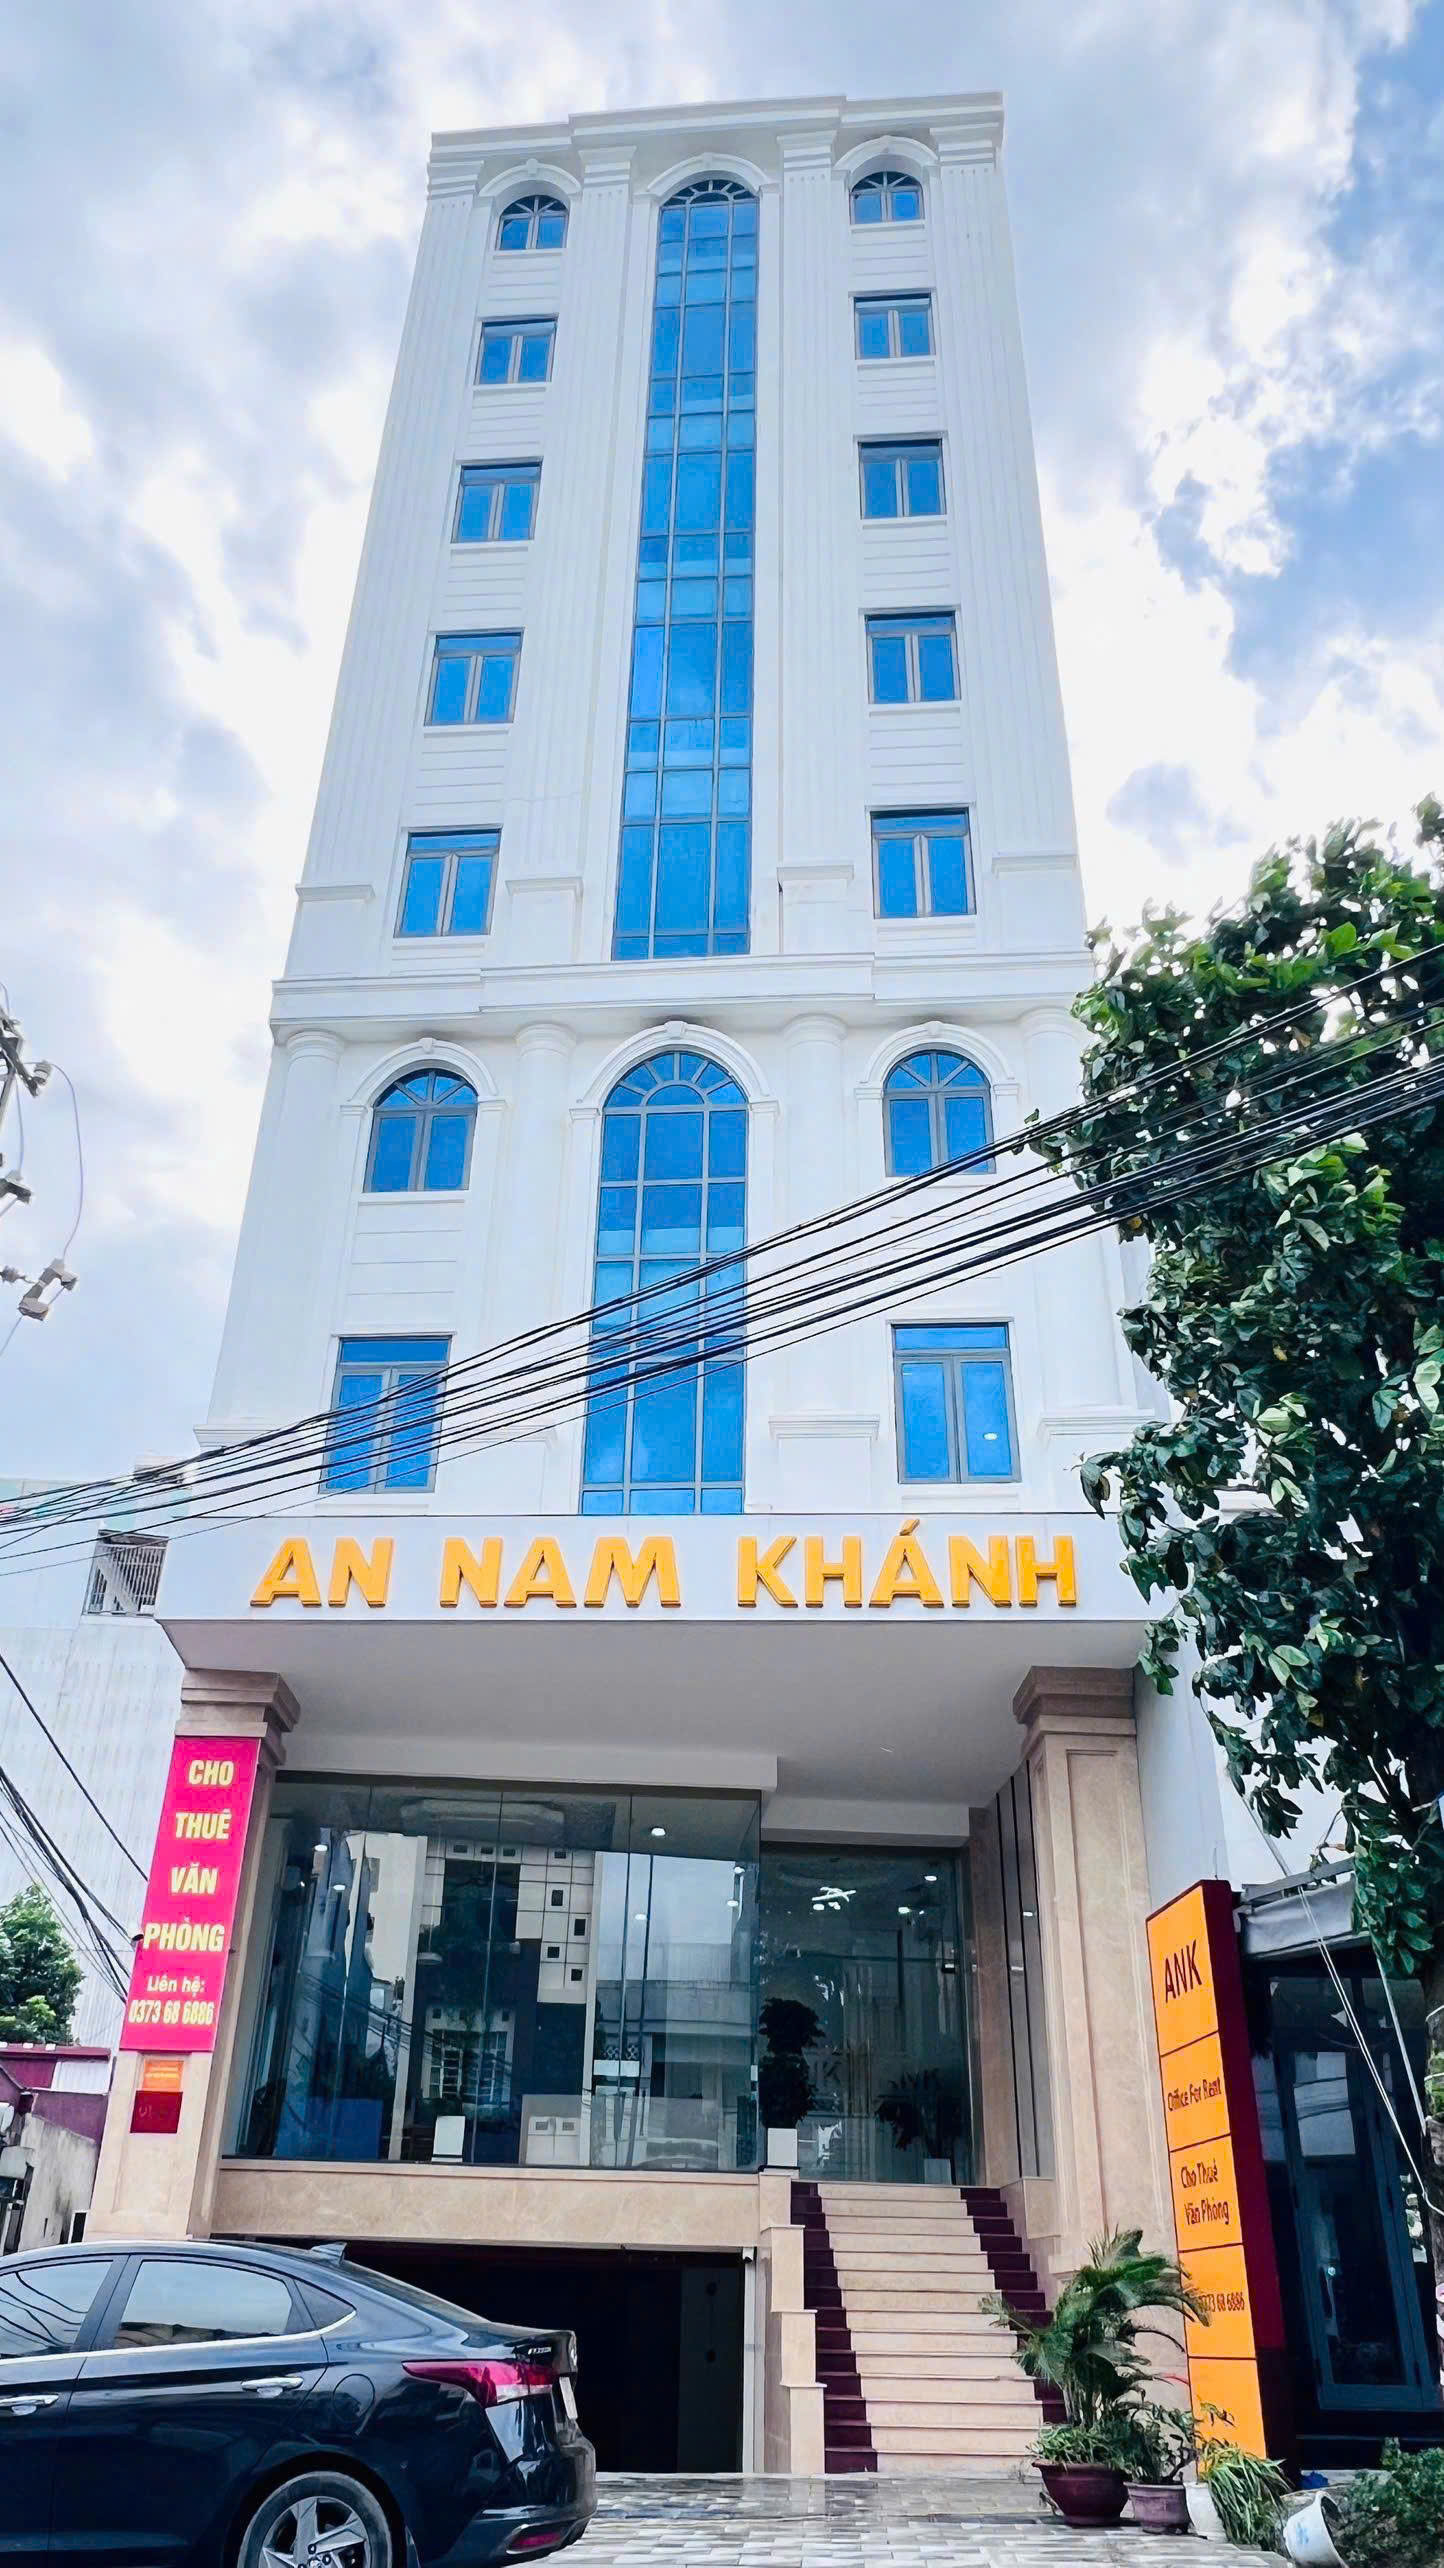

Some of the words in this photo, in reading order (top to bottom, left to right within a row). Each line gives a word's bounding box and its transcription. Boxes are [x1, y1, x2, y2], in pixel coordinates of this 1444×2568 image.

[250, 1536, 394, 1608] AN
[439, 1536, 681, 1608] NAM
[737, 1518, 1077, 1609] KHÁNH
[188, 1759, 235, 1786] CHO
[175, 1808, 232, 1840] THUÊ
[170, 1862, 219, 1895] VĂN
[143, 1916, 225, 1952] PHÒNG
[146, 1974, 177, 1992] Liên
[181, 1975, 205, 1998] hệ:
[1165, 1939, 1203, 2003] ANK
[128, 2000, 160, 2024] 0373
[163, 2000, 180, 2024] 68
[182, 2001, 215, 2025] 6886
[1167, 2087, 1190, 2112] Office
[1190, 2083, 1202, 2103] For
[1180, 2166, 1196, 2189] Cho
